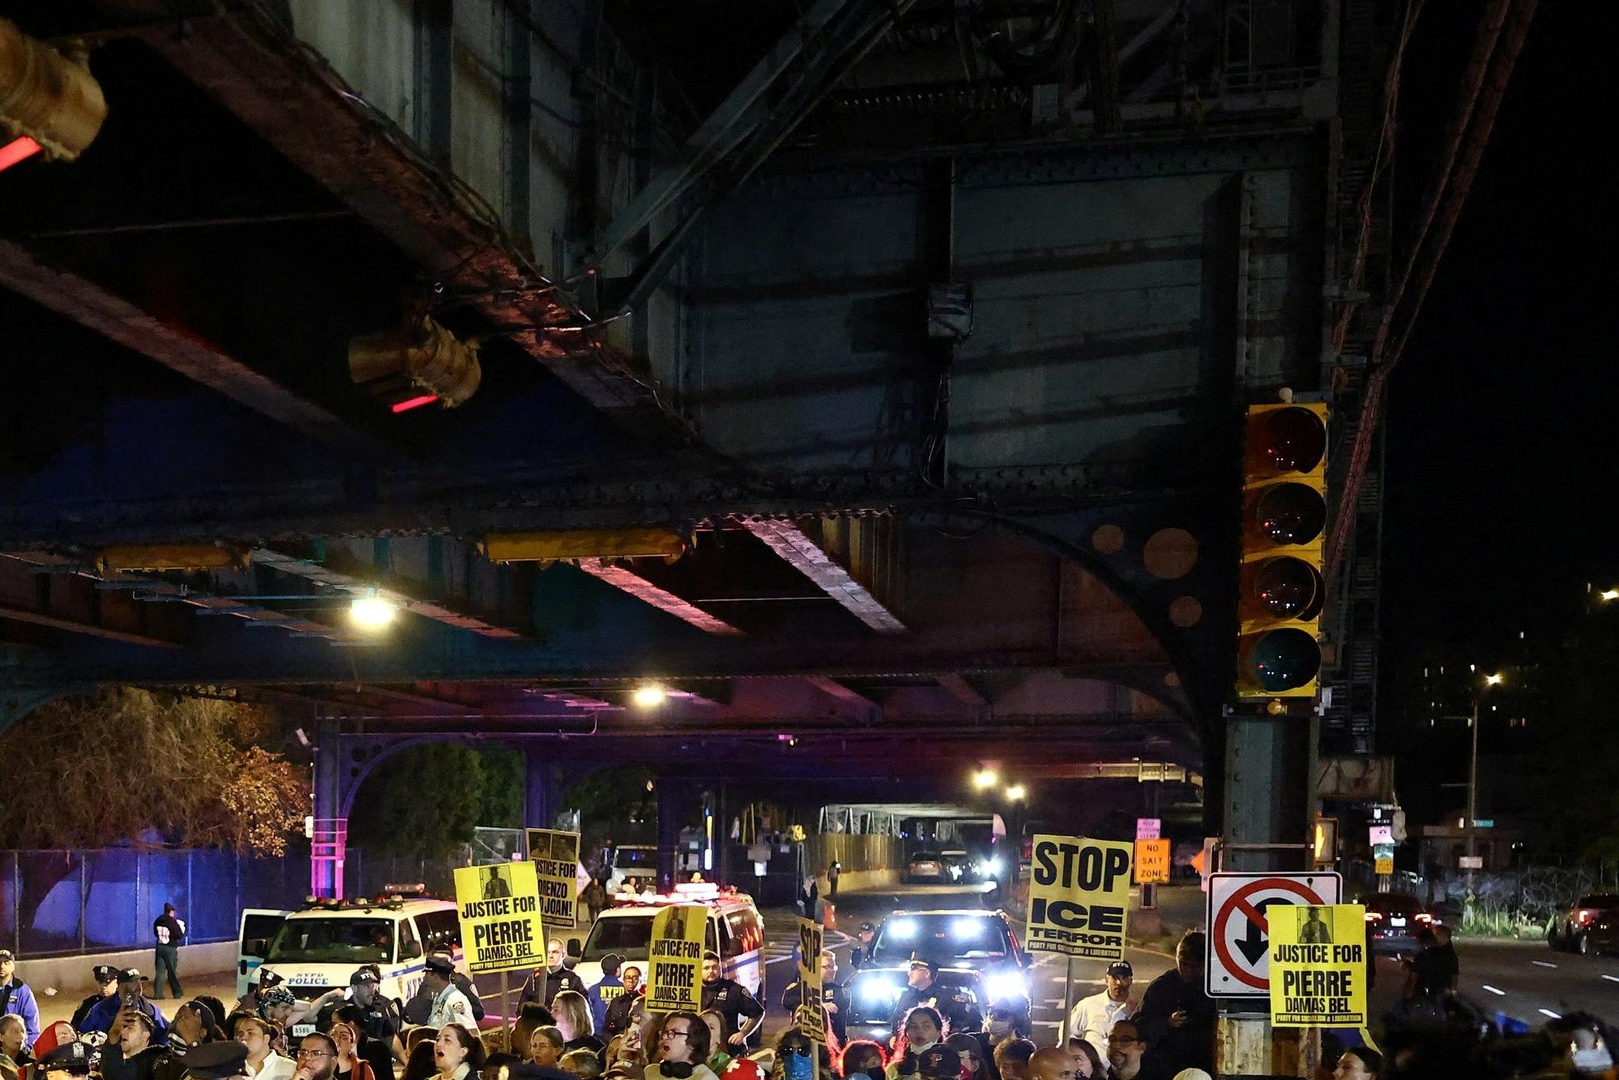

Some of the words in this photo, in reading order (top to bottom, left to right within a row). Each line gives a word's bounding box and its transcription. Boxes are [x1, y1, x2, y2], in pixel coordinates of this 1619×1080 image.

[1146, 844, 1159, 852] NO
[534, 859, 557, 876] USTICE
[559, 862, 576, 878] FOR
[1034, 841, 1129, 892] STOP
[538, 879, 568, 898] ORENZO
[462, 898, 510, 919] JUSTICE
[513, 896, 536, 913] FOR
[1031, 898, 1124, 932] ICE
[474, 919, 534, 948] PIERRE
[1029, 926, 1123, 946] TERROR
[477, 945, 513, 962] DAMAS
[516, 943, 534, 957] BEL
[652, 940, 681, 956] JUSTICE
[682, 941, 700, 958] FOR
[1274, 944, 1329, 963] JUSTICE
[1333, 945, 1362, 963] FOR
[655, 963, 695, 987] PIERRE
[1283, 970, 1353, 997] PIERRE
[600, 986, 625, 998] NYPD
[679, 988, 693, 1001] BEL
[1285, 997, 1326, 1013] DAMAS
[1329, 998, 1351, 1012] BEL
